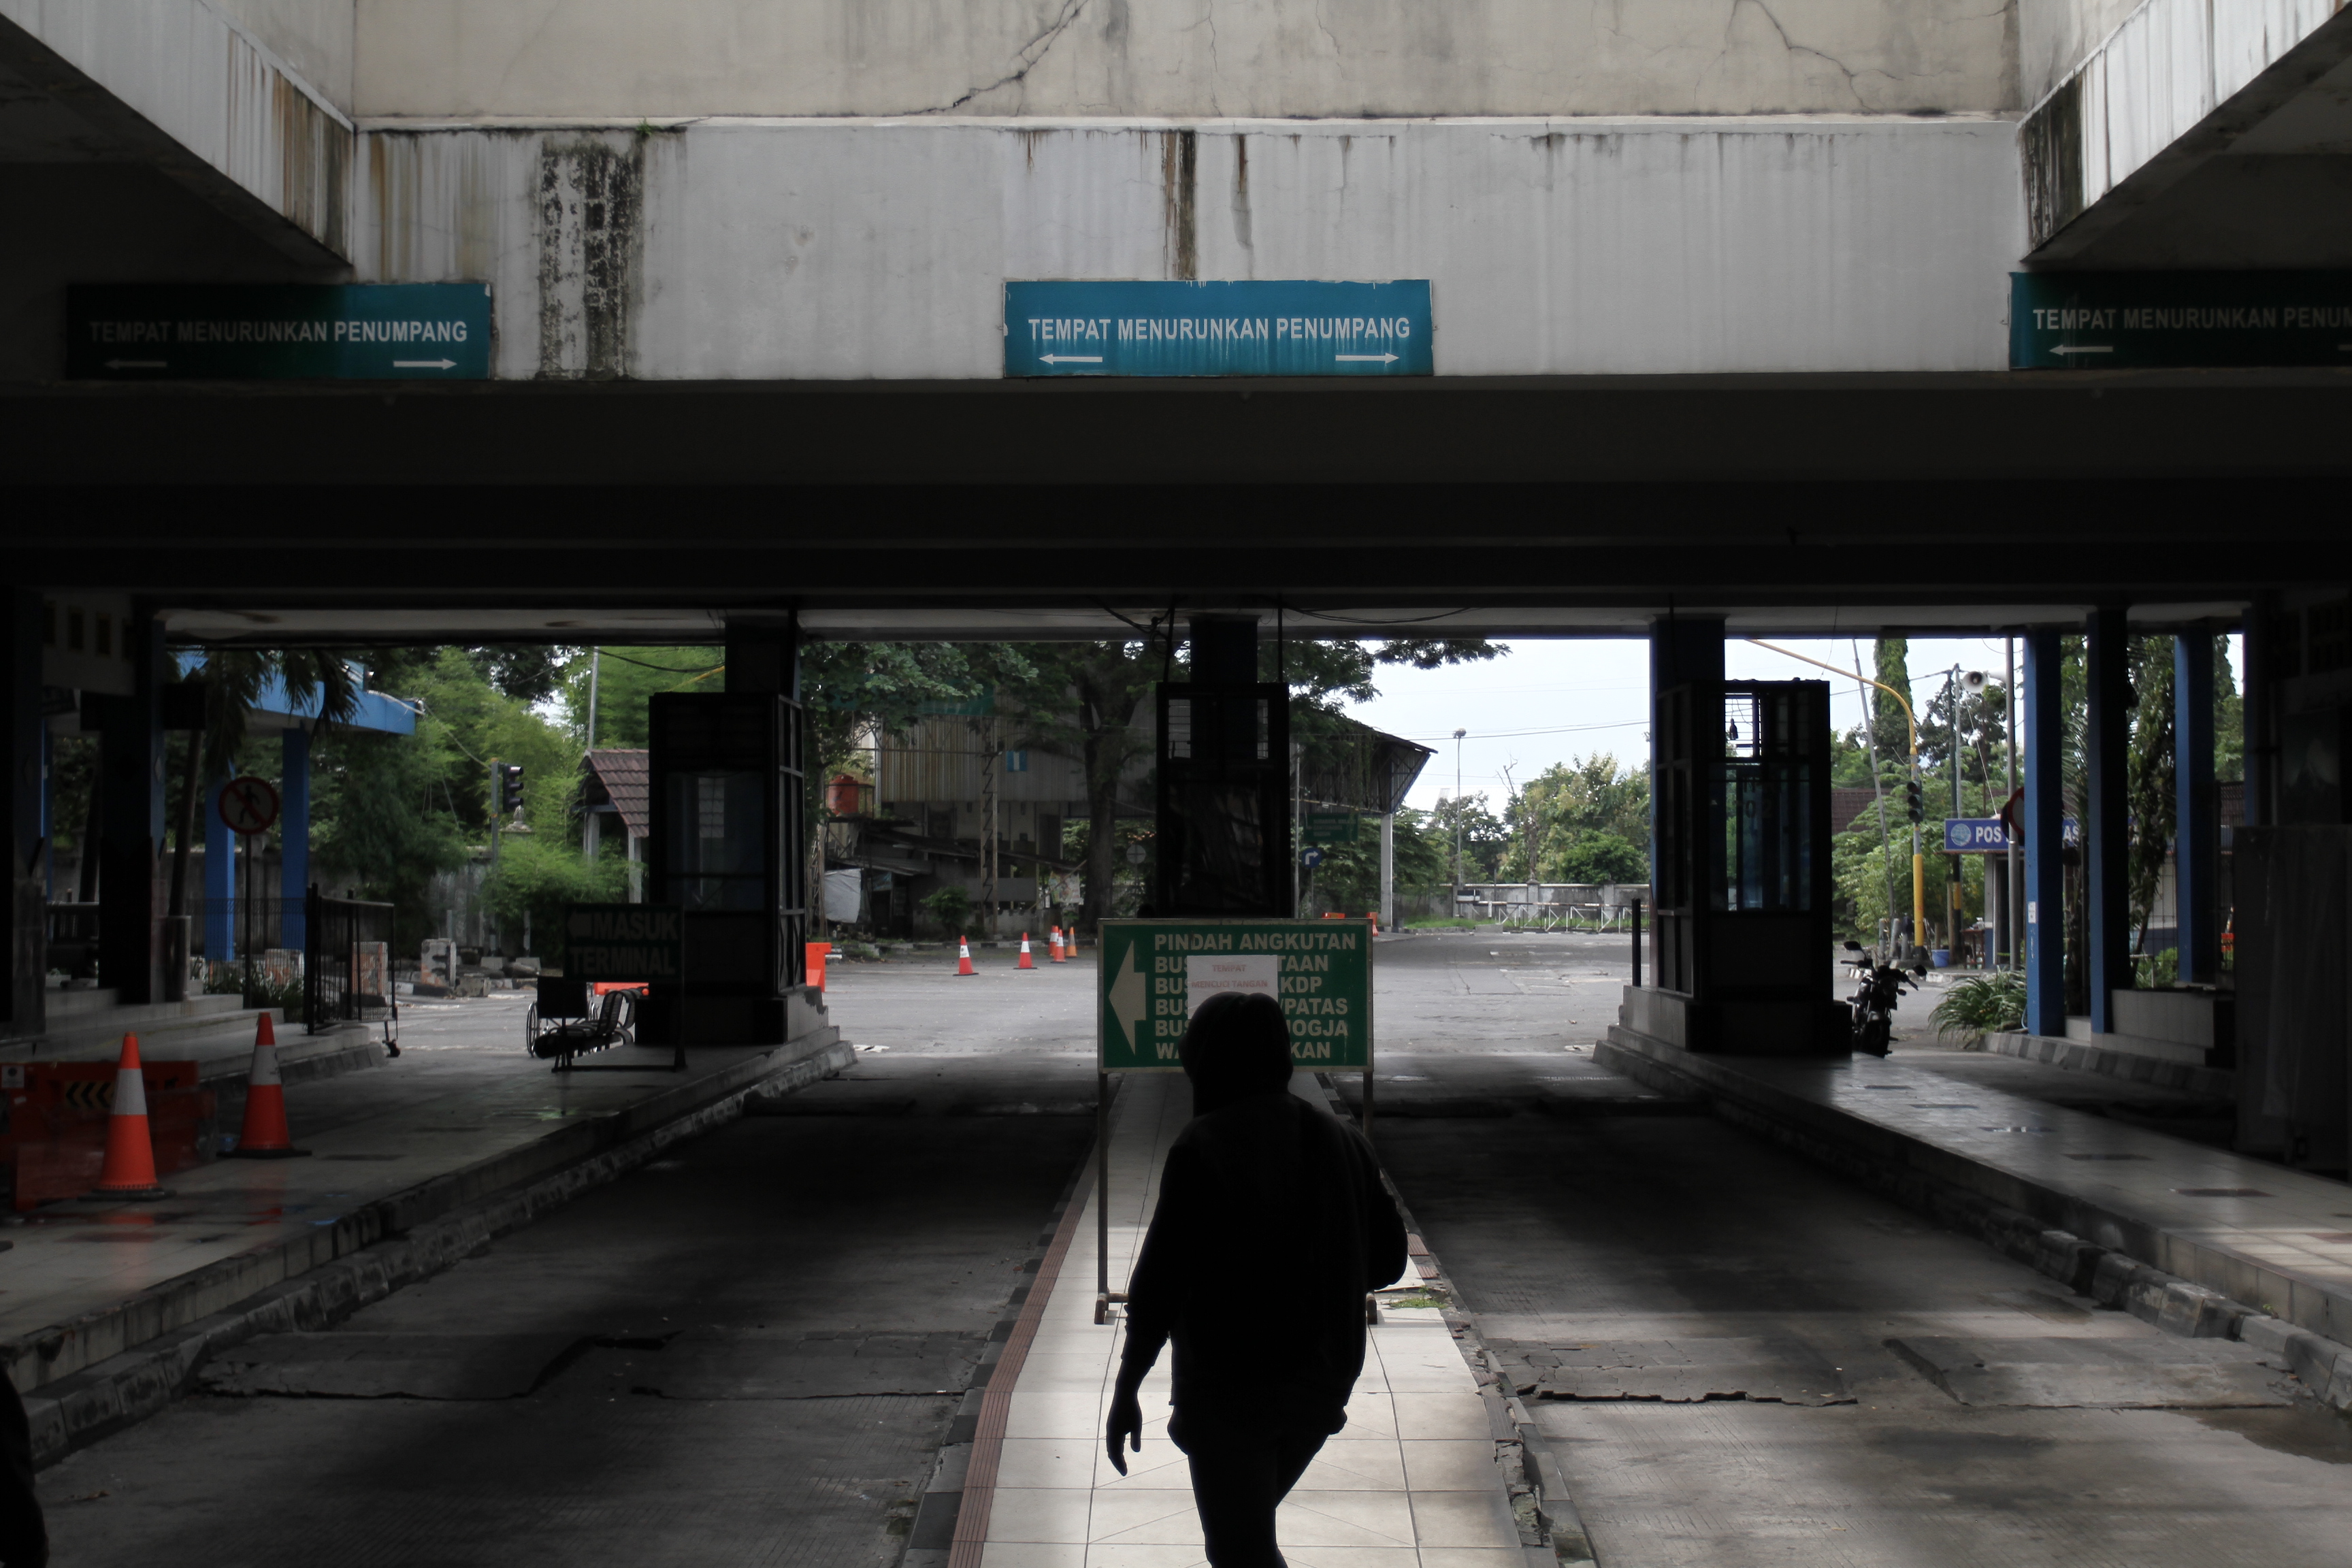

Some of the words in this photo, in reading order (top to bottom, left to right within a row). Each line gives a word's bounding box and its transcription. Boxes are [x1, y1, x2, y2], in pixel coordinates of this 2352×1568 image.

[2033, 308, 2117, 330] TEMPAT
[2123, 307, 2276, 329] MENURUNKAN
[89, 321, 172, 342] TEMPAT
[177, 321, 328, 342] MENURUNKAN
[335, 320, 468, 342] PENUMPANG
[1028, 318, 1111, 340] TEMPAT
[1118, 318, 1269, 340] MENURUNKAN
[1277, 316, 1411, 340] PENUMPANG
[1975, 826, 2002, 843] POS
[593, 911, 679, 941] MASUK
[1155, 933, 1232, 951] PINDAH
[1239, 932, 1356, 950] ANGKUTAN
[568, 946, 676, 975] TERMINAL
[1155, 956, 1188, 973] BU
[1277, 955, 1328, 972] TAAN
[1211, 964, 1247, 973] TEMPAT
[1155, 978, 1188, 994] BU
[1278, 976, 1322, 993] KDP
[1191, 980, 1229, 988] MENCUCI
[1231, 979, 1268, 987] TANGAN
[1155, 998, 1189, 1015] BU
[1280, 998, 1348, 1015] /PATAS
[1290, 1042, 1330, 1058] KAN
